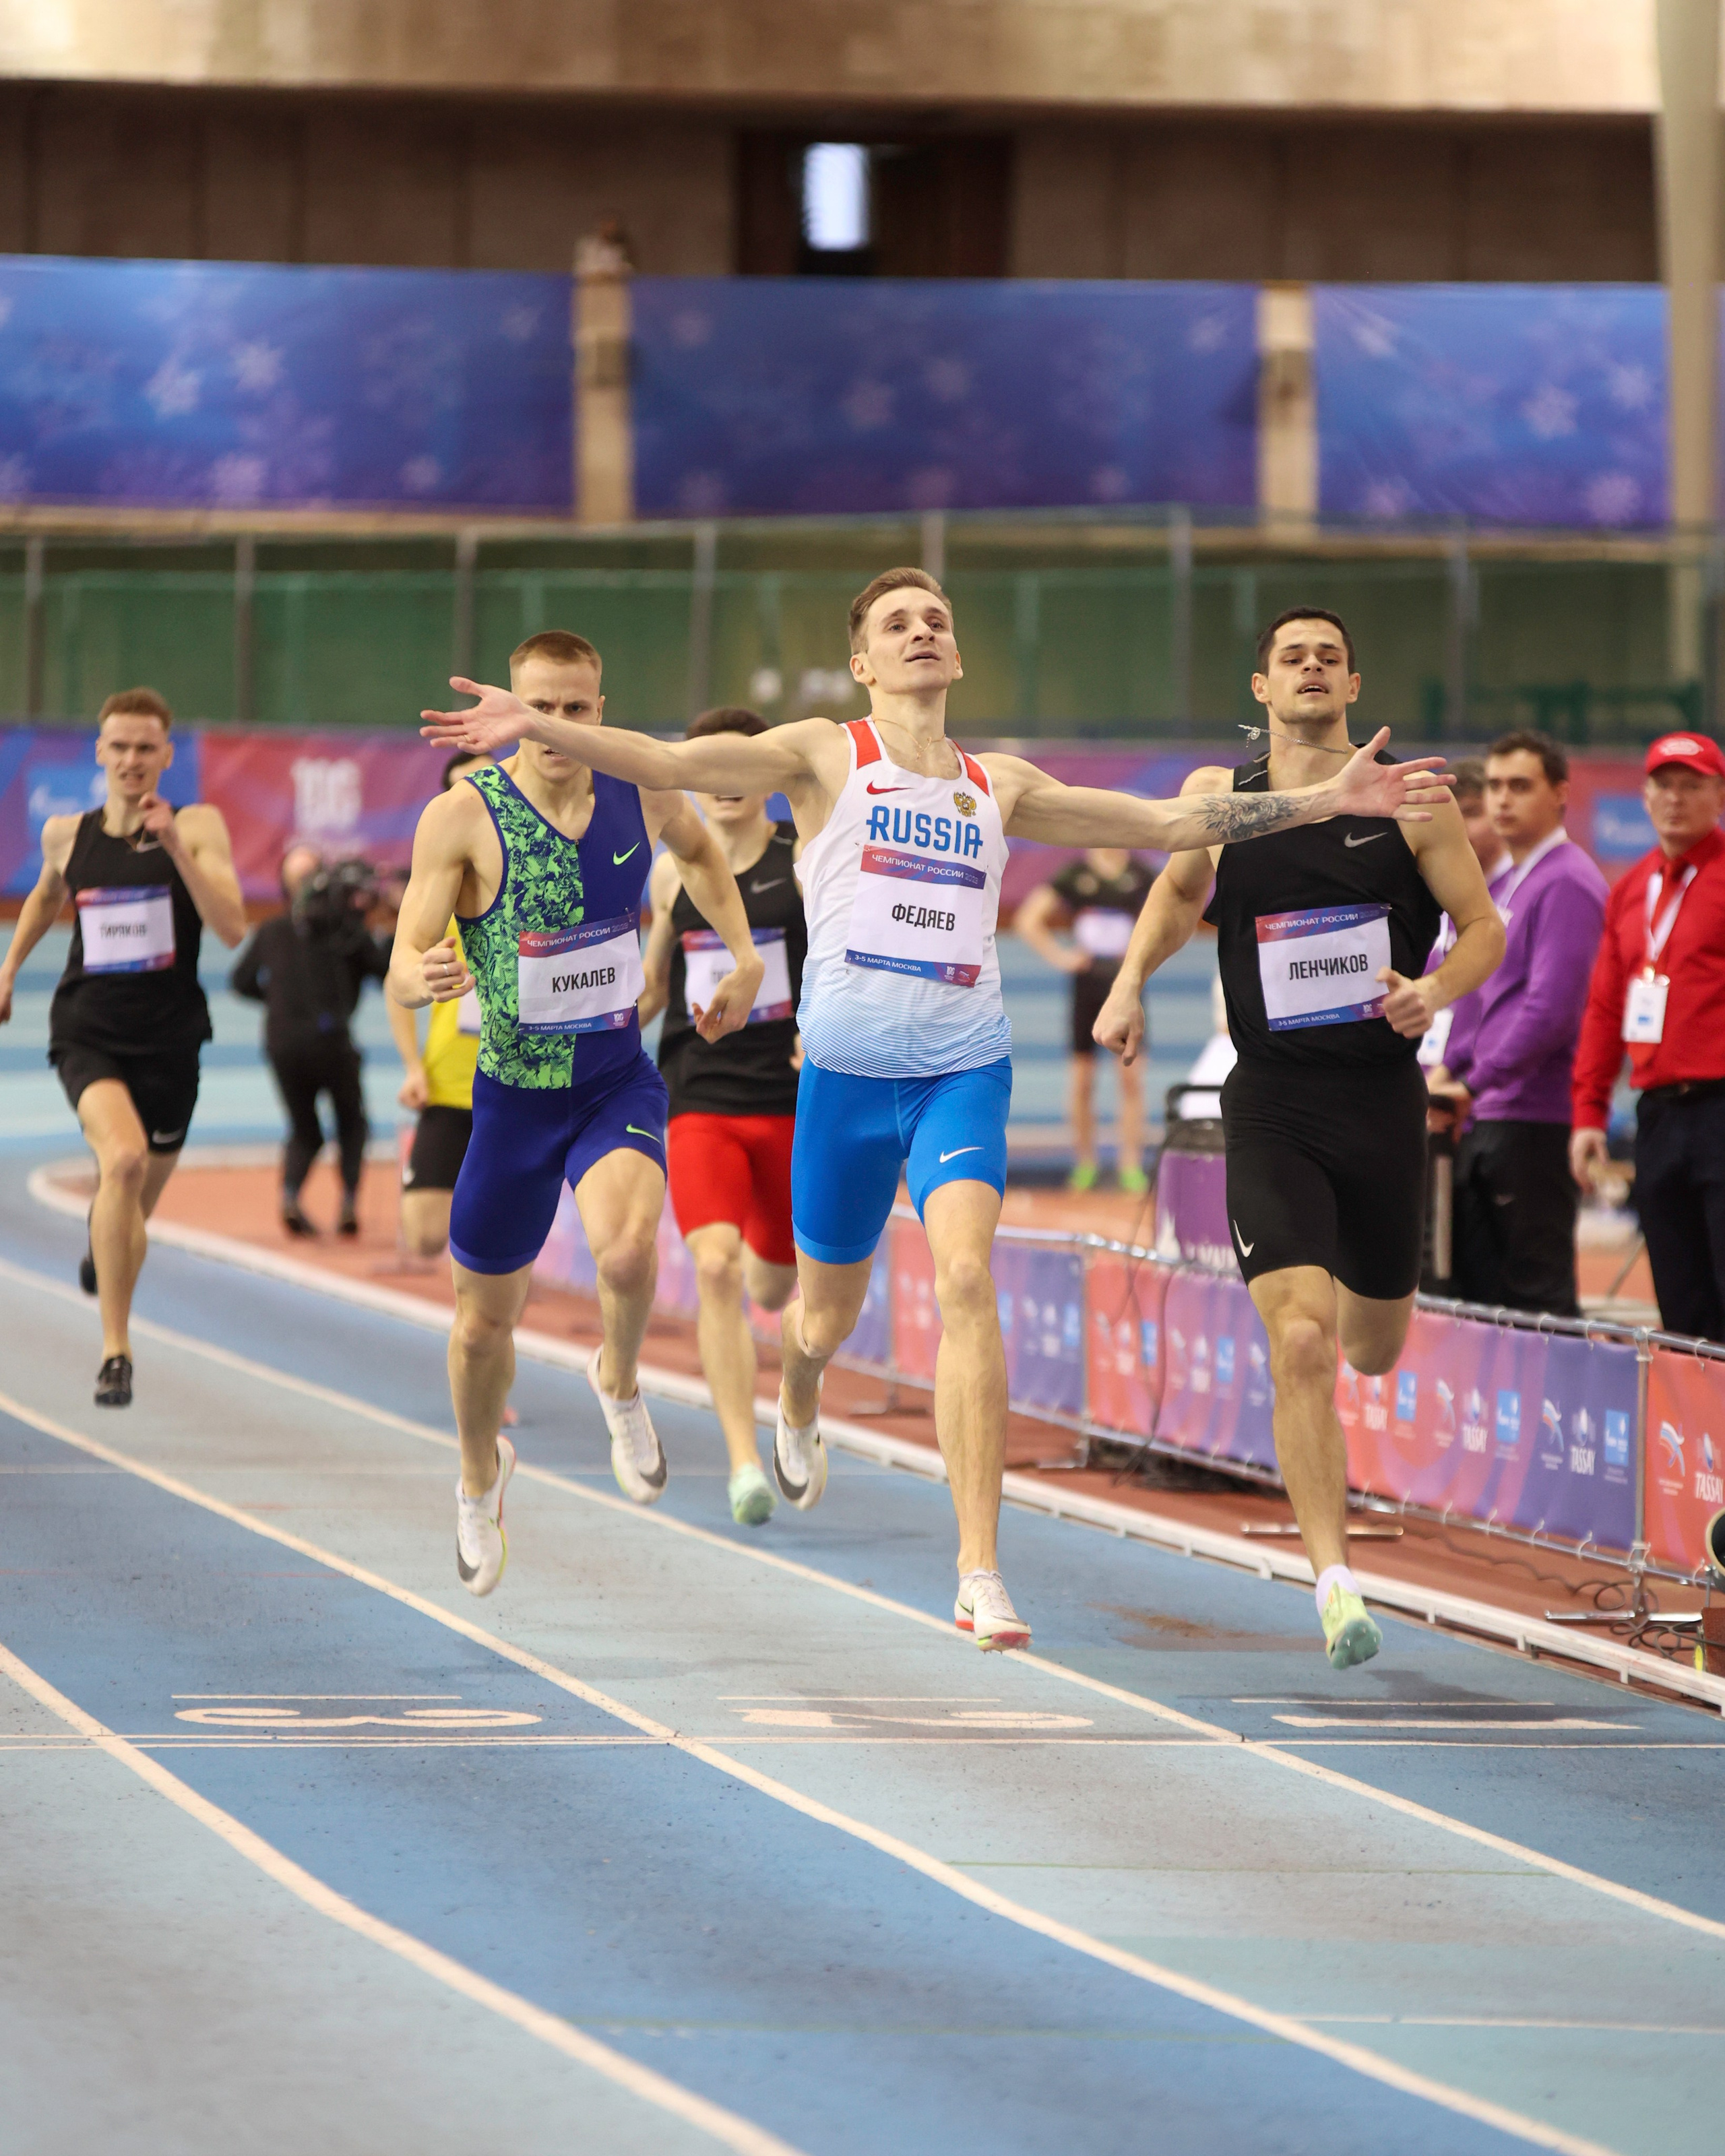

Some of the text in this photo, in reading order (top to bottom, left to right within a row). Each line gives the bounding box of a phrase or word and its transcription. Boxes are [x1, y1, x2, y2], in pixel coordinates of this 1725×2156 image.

[866, 805, 983, 859] RUSSIA
[872, 854, 926, 872] ЧЕМПИОНАТ
[927, 866, 964, 879] РОССИИ
[891, 903, 955, 931] ФЕДЯЕВ
[1265, 918, 1319, 930] ЧЕМПИОНАТ
[1322, 913, 1358, 923] РОССИИ
[527, 934, 577, 947] ЧЕМПИОНАТ
[579, 927, 610, 940] РОССИИ
[867, 957, 891, 966] МАРТА
[891, 962, 922, 972] МОСКВА
[1290, 953, 1369, 980] ЛЕНЧИКОВ
[553, 967, 615, 993] КУКАЛЕВ
[564, 1022, 592, 1030] МОСКВА
[1288, 1017, 1311, 1025] МАРТА
[1311, 1013, 1340, 1021] МОСКВА
[1571, 1446, 1596, 1476] TASSAY
[1695, 1471, 1724, 1504] TASSAY
